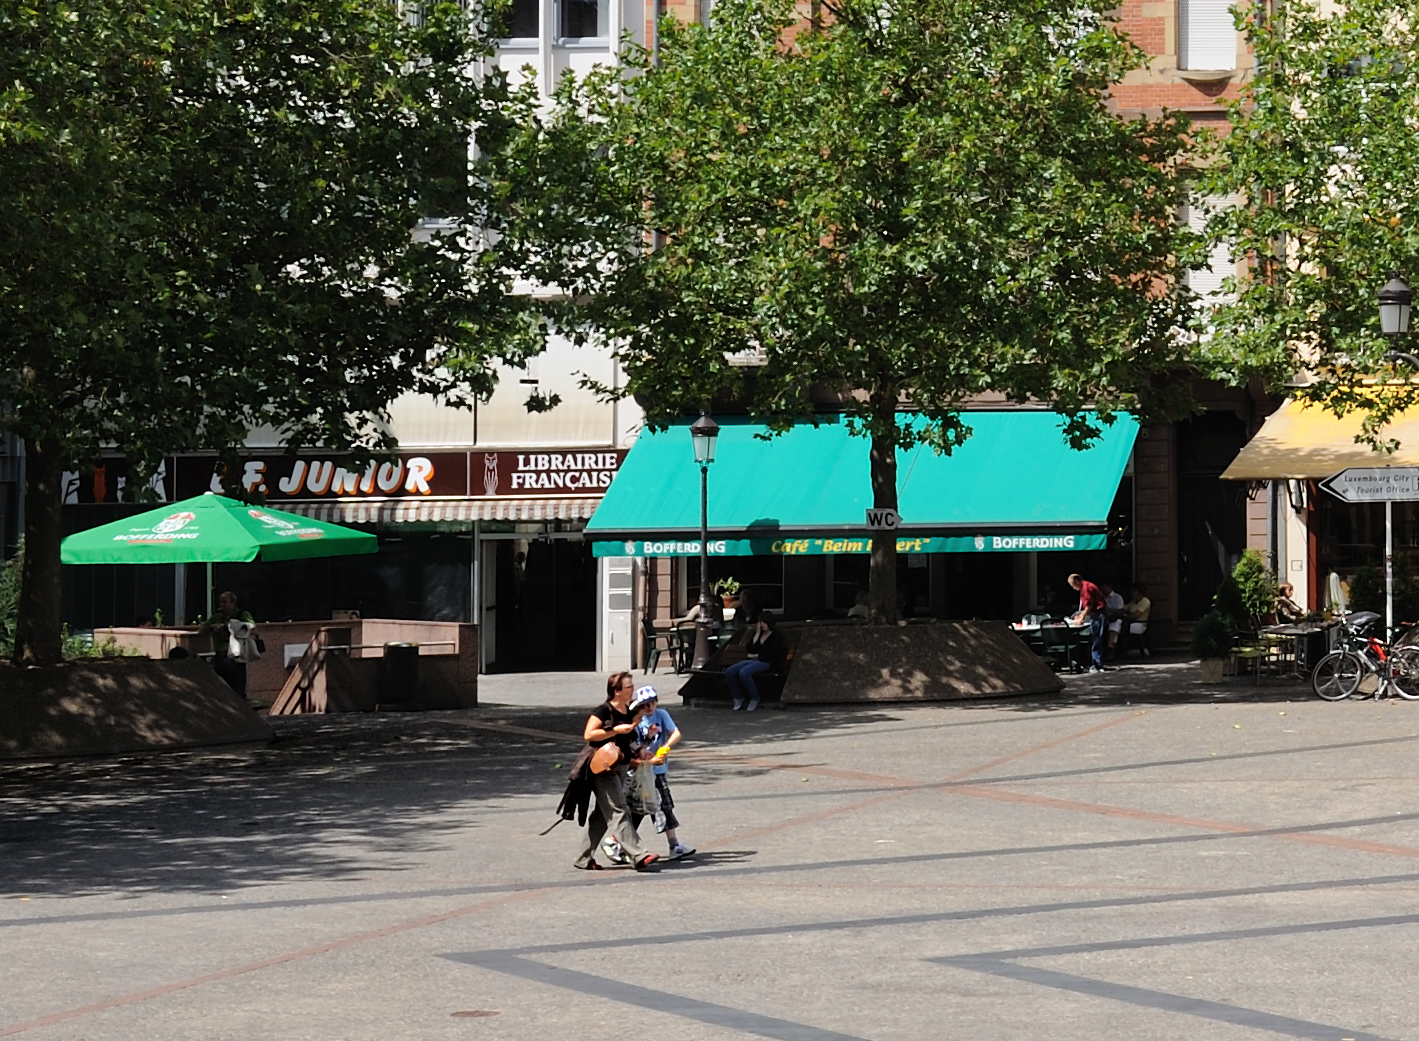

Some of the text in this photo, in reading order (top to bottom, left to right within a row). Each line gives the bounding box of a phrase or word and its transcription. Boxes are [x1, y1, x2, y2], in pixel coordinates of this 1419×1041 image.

[517, 453, 618, 471] LIBRAIRIE
[278, 457, 435, 495] JUNIOR
[1344, 474, 1410, 484] Luxembourg City
[1356, 486, 1410, 494] Tourist Office
[868, 512, 895, 527] WC
[643, 540, 726, 554] BOFFERDNG
[771, 539, 809, 555] Café
[992, 535, 1075, 549] BOFFERDING
